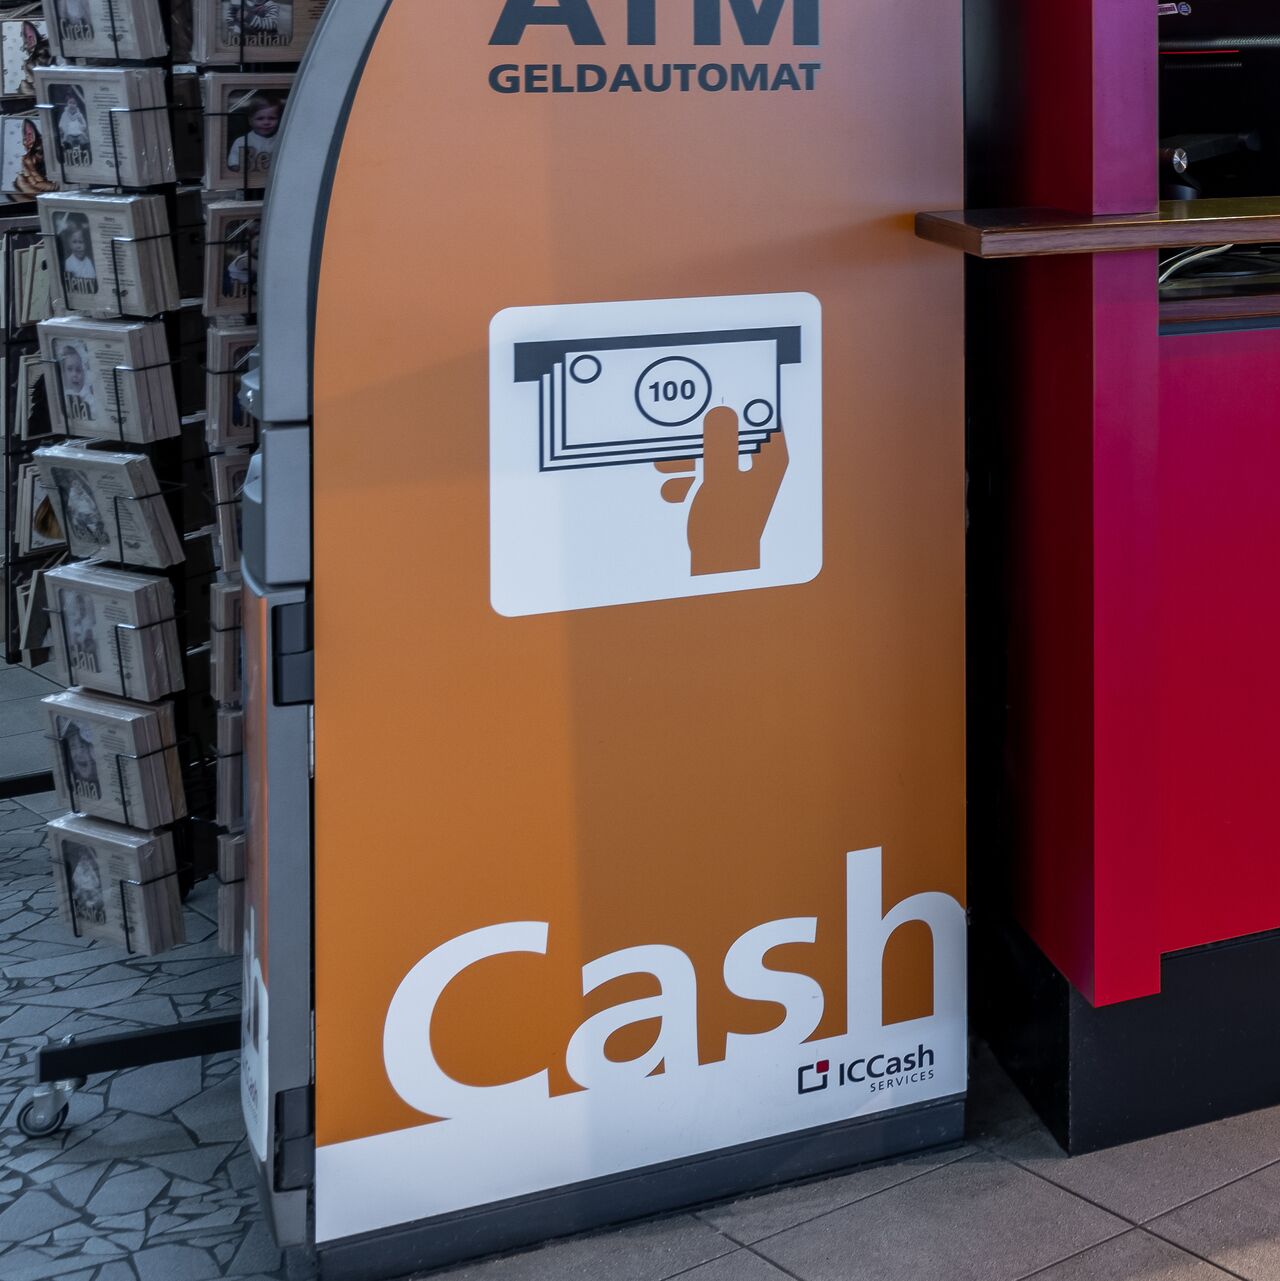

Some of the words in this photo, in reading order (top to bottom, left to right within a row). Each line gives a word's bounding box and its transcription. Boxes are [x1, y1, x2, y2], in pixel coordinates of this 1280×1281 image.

[223, 31, 291, 47] Jonathan
[487, 62, 822, 94] GELDAUTOMAT
[647, 378, 697, 402] 100
[382, 846, 967, 1120] Cash
[839, 1043, 935, 1086] ICCash
[869, 1069, 934, 1093] SERVICES
